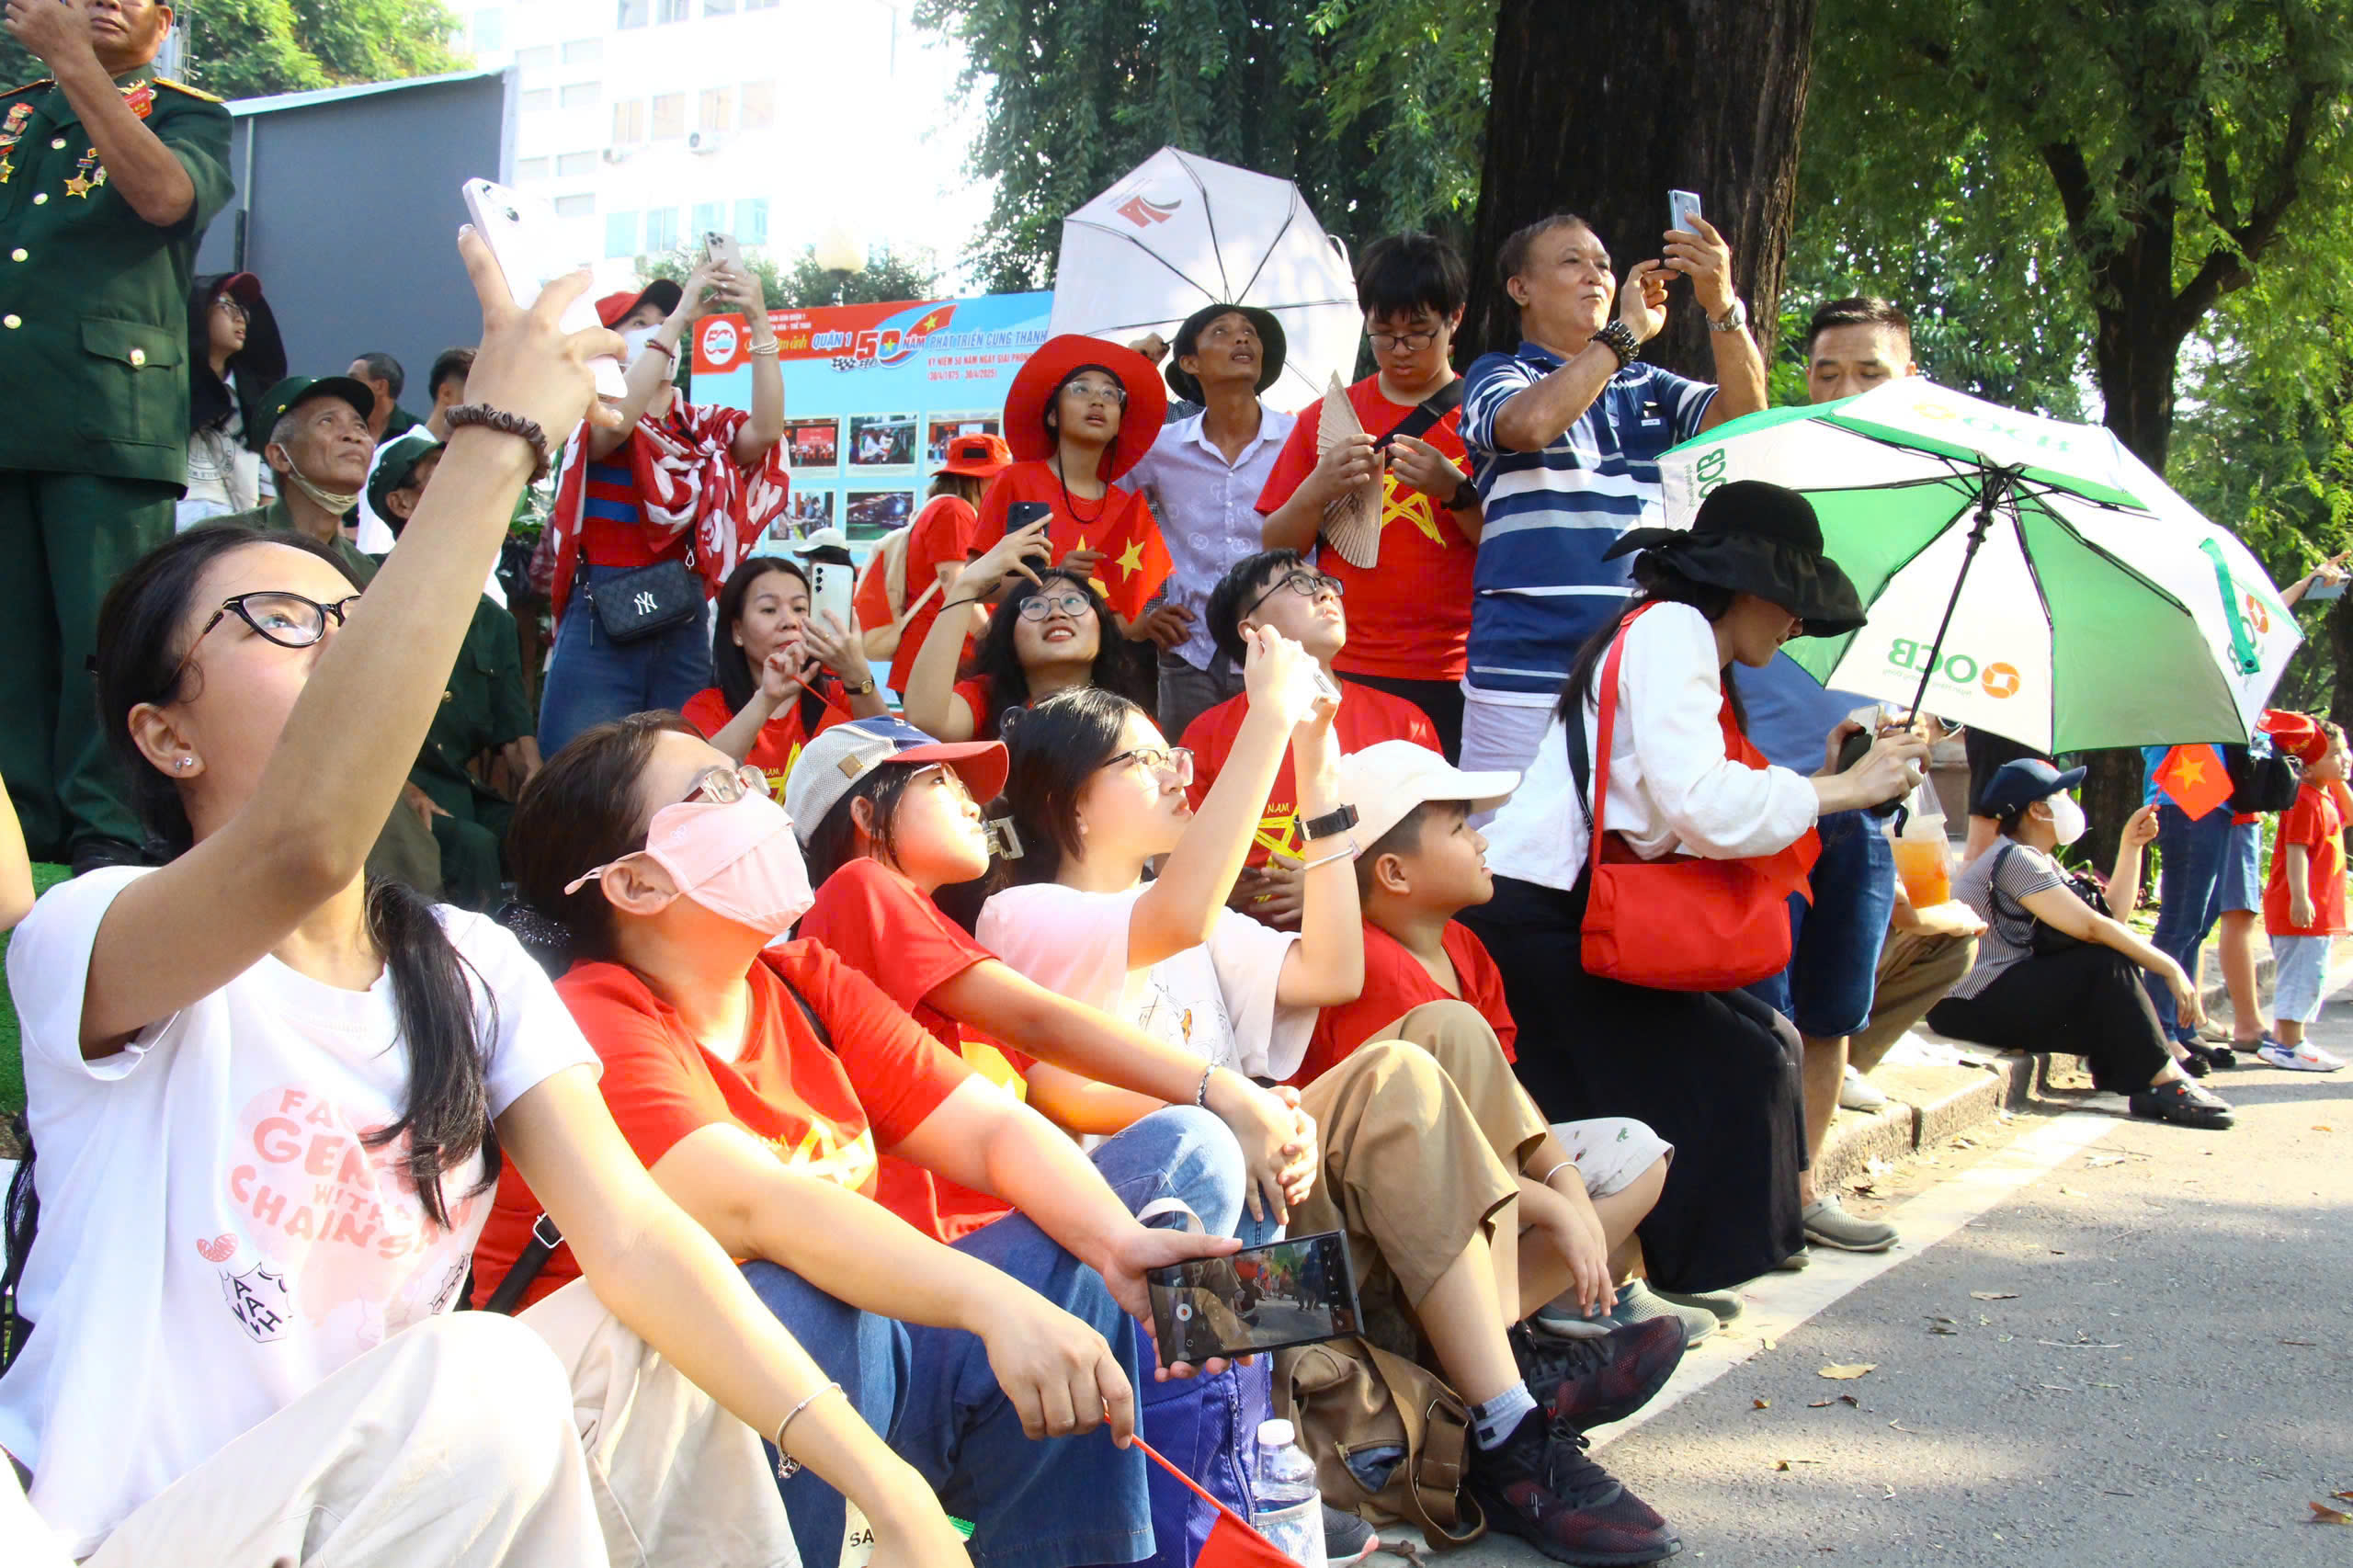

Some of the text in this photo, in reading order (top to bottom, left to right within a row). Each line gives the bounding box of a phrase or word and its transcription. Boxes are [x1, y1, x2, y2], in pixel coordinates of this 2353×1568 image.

[812, 330, 845, 351] QUẬN
[845, 331, 854, 347] 1
[903, 334, 927, 350] NĂM
[633, 591, 658, 616] NY
